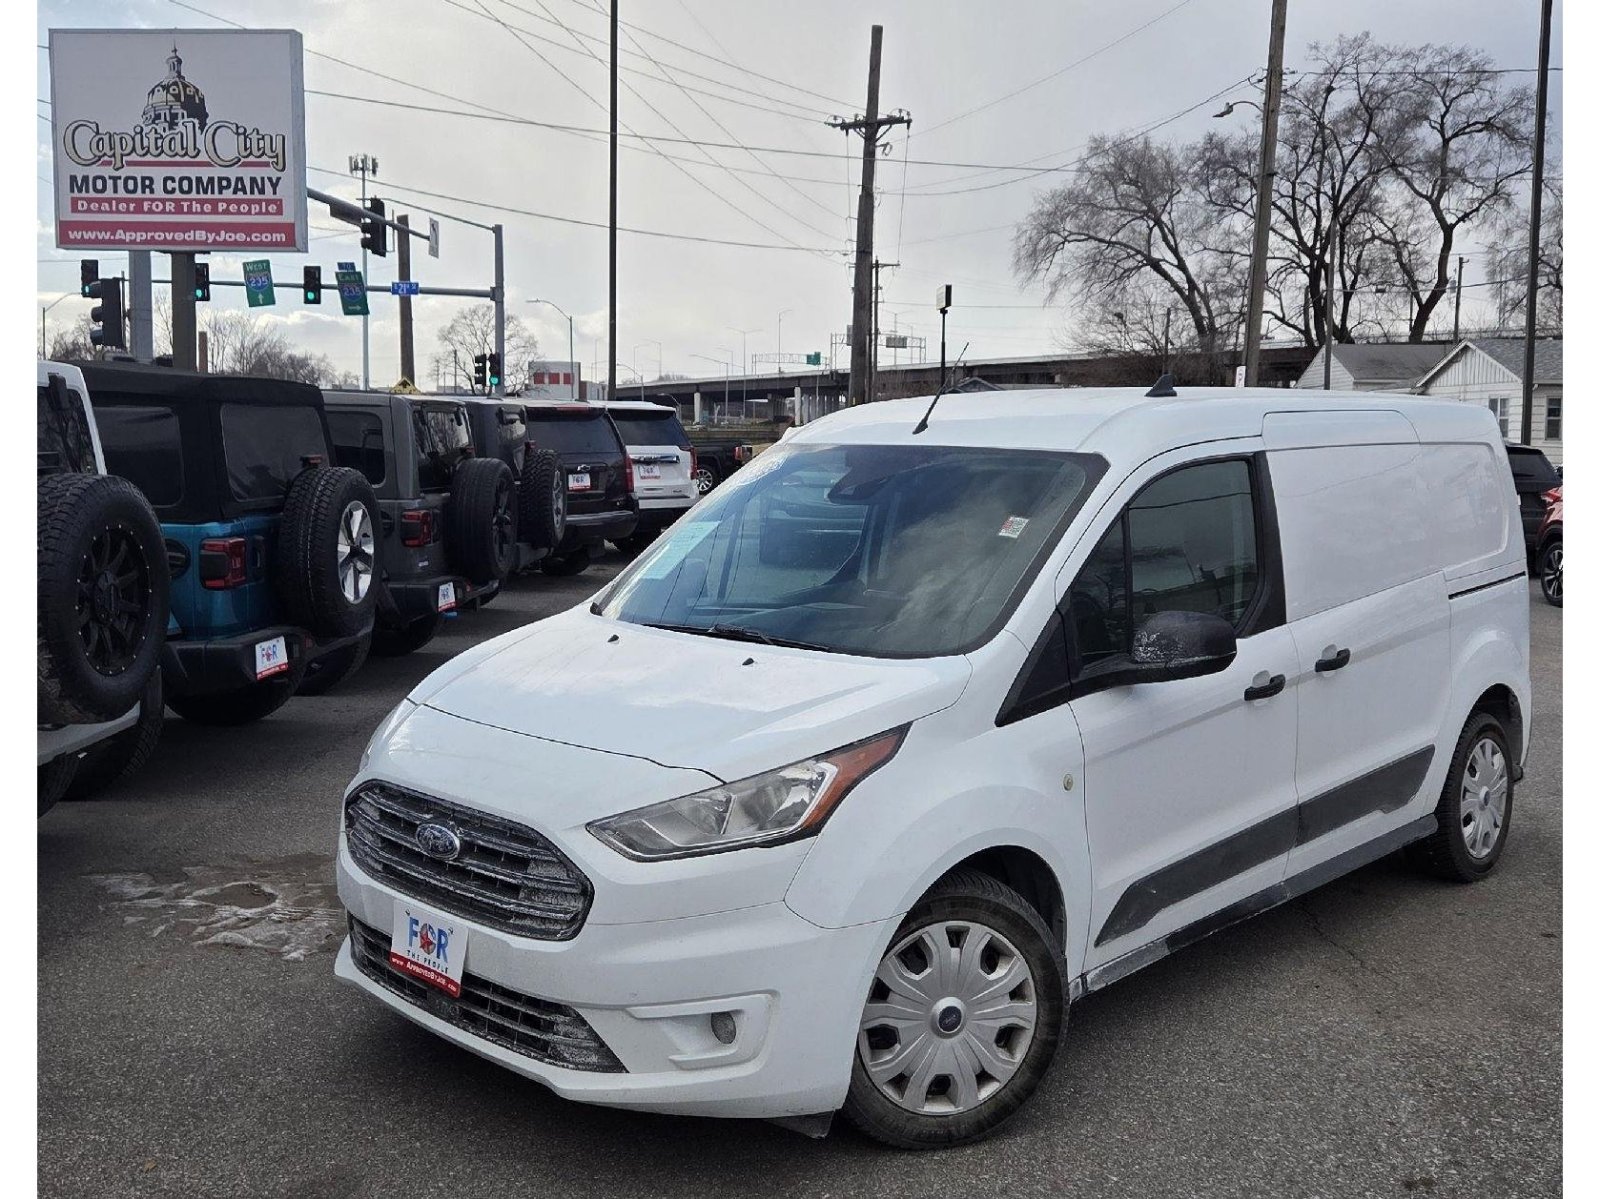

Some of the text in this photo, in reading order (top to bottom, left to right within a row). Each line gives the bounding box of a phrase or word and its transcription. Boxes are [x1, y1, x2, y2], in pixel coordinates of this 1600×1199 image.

[63, 120, 286, 172] Capital City
[69, 174, 282, 195] MOTOR COMPANY
[77, 200, 278, 214] Dealer FOR The People
[68, 229, 286, 242] www.ApprovedByJoe.com
[250, 276, 268, 287] 235
[343, 286, 361, 296] 235
[408, 916, 449, 964] FOR
[406, 950, 420, 960] THE
